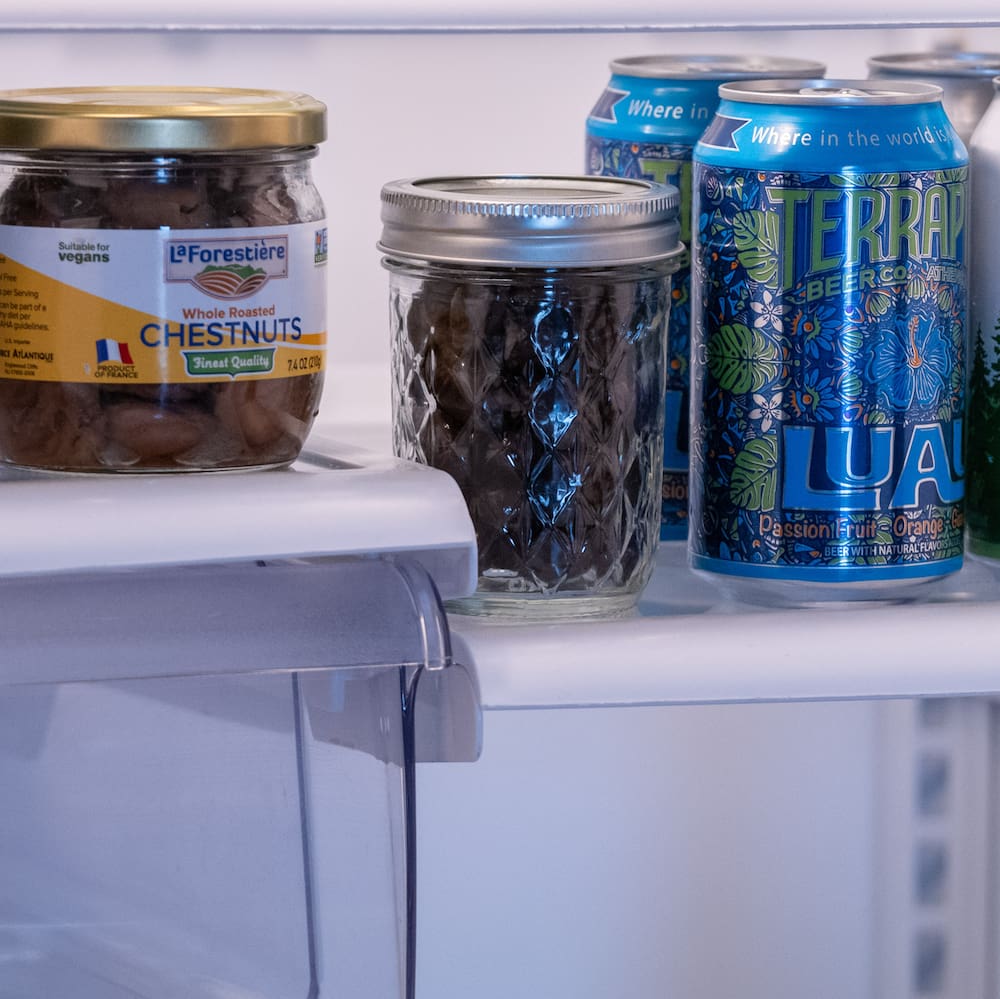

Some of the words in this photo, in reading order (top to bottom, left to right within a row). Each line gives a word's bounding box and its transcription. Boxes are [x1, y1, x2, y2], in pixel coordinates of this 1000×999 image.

[628, 99, 684, 119] Where
[690, 103, 709, 119] in
[751, 125, 812, 147] Where
[820, 129, 839, 146] in
[847, 128, 881, 146] the
[886, 124, 934, 146] world
[933, 124, 947, 142] is
[58, 241, 96, 251] Suitable
[96, 242, 110, 251] for
[58, 252, 110, 264] vegans
[806, 268, 877, 302] BEER
[14, 289, 39, 299] Serving
[33, 303, 42, 312] of
[182, 308, 226, 320] Whole
[229, 304, 276, 319] Roasted
[140, 317, 302, 348] CHESTNUTS
[192, 355, 229, 369] Finest
[231, 354, 270, 369] Quality
[299, 357, 308, 370] OZ
[107, 371, 139, 379] FRANCE
[759, 514, 831, 539] Passion
[835, 517, 877, 539] Fruit
[892, 515, 944, 540] Orange
[823, 545, 850, 557] BEER
[851, 545, 877, 556] WITH
[878, 543, 919, 556] NATURAL
